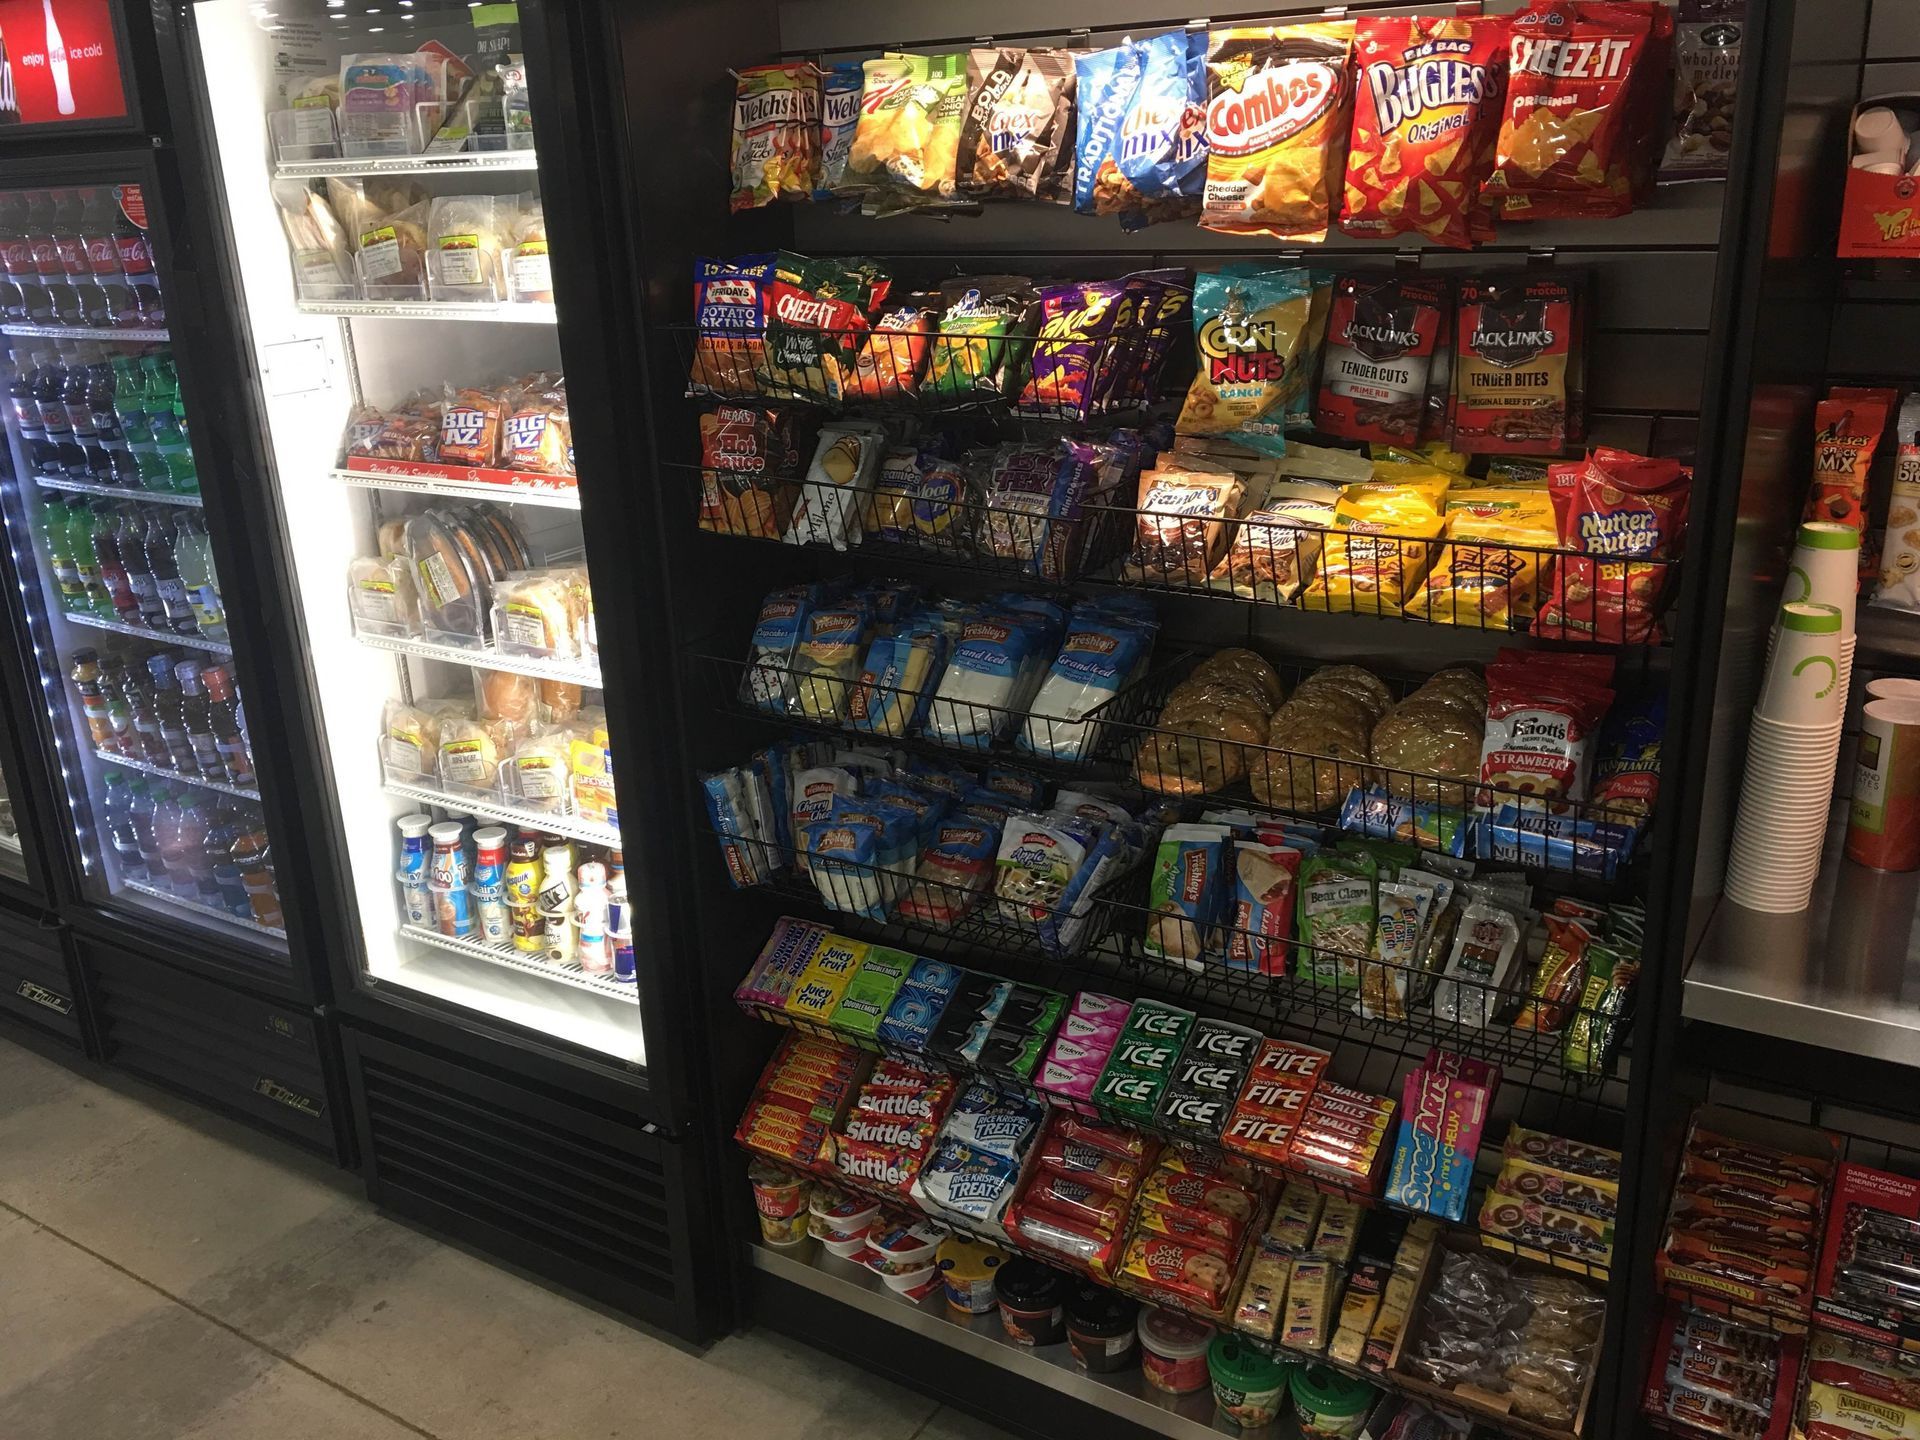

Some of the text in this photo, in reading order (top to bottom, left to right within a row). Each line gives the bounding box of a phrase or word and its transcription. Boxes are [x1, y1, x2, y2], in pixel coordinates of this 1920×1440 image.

[22, 43, 103, 66] enjoy ice cold
[1436, 41, 1472, 54] BAG
[971, 70, 1010, 121] BOLD
[1208, 70, 1322, 138] Combos
[1368, 60, 1485, 137] BUGLES
[739, 94, 789, 123] Welch's
[1207, 184, 1248, 194] Cheddar
[1208, 192, 1246, 202] Cheese
[1400, 290, 1439, 303] Protein
[1461, 287, 1477, 299] 70
[1525, 286, 1568, 297] Protein
[703, 308, 757, 321] POTATO
[776, 293, 837, 329] CHEEZ-IT
[1199, 318, 1276, 358] CORN
[1341, 320, 1420, 348] JACK LINK'S
[1470, 330, 1553, 349] JACK LINK'S
[1210, 354, 1285, 386] NUTS
[1340, 360, 1409, 385] TENDER CUTS
[1470, 371, 1549, 389] TENDER BITES
[1219, 386, 1263, 399] RANCH
[1349, 385, 1390, 399] PRIME RIB
[1469, 397, 1503, 407] ORIGINAL
[1504, 397, 1521, 406] BEEF
[442, 410, 485, 431] BIG
[504, 414, 547, 432] BIG
[445, 429, 480, 446] AZ
[508, 431, 541, 449] AZ
[719, 433, 757, 456] Hot
[711, 450, 765, 472] Sauce
[1822, 445, 1857, 458] SNACK
[1002, 492, 1046, 505] Cinnamon
[1060, 462, 1084, 517] Mini Donuts
[806, 492, 835, 540] Milano
[1582, 512, 1653, 536] Nutter
[1586, 530, 1659, 554] Butter
[1600, 562, 1654, 581] Bites
[762, 601, 796, 617] Freshley's
[756, 627, 789, 638] Cupcakes
[962, 626, 1008, 640] Freshley's
[984, 653, 1009, 666] Iced
[1057, 654, 1117, 679] Grand Iced
[1511, 718, 1566, 741] Knott's
[1494, 753, 1569, 771] STRAWBERRY
[797, 800, 829, 813] Cherry
[1358, 798, 1401, 816] NUTRI
[1353, 809, 1399, 827] GRAIN
[1513, 817, 1562, 831] NUTRI
[1011, 846, 1046, 862] Apple
[1493, 845, 1541, 864] NUTRI
[1166, 865, 1182, 897] Apple
[1311, 886, 1369, 905] Bear Claw
[1255, 906, 1273, 951] Cherry
[1380, 914, 1397, 951] Crunch
[769, 926, 797, 965] mentos
[776, 926, 806, 972] mentos
[788, 931, 819, 977] mentos
[821, 945, 854, 964] Juicy
[818, 956, 848, 974] Fruit
[864, 961, 901, 977] DOUBLEMINT
[799, 981, 834, 1002] Juicy
[904, 976, 950, 997] Winterfresh
[796, 994, 827, 1011] Fruit
[842, 999, 880, 1016] DOUBLEMINT
[1080, 997, 1109, 1013] Trident
[1137, 1005, 1168, 1016] Dentyne
[883, 1014, 929, 1036] Winterfresh
[1067, 1019, 1097, 1036] Trident
[1133, 1011, 1186, 1037] ICE
[1199, 1024, 1230, 1036] Dentyne
[1054, 1042, 1086, 1058] Trident
[1123, 1037, 1153, 1048] Dentyne
[1195, 1031, 1251, 1057] ICE
[792, 1053, 832, 1074] Starburst
[796, 1043, 838, 1065] Starburst
[1118, 1044, 1173, 1069] ICE
[1259, 1050, 1322, 1077] FIRE
[779, 1066, 820, 1086] Starburst
[1046, 1065, 1075, 1082] Trident
[1106, 1069, 1138, 1080] Dentyne
[1180, 1064, 1236, 1090] ICE
[772, 1079, 813, 1100] Starburst
[1102, 1076, 1158, 1102] ICE
[1244, 1083, 1307, 1111] FIRE
[1330, 1083, 1374, 1103] HALLS
[760, 1104, 801, 1126] Starburst
[857, 1095, 931, 1118] Skittles
[1323, 1099, 1366, 1119] HALLS
[974, 1121, 1027, 1139] TREATS
[977, 1114, 1031, 1127] RICE KRISPIES
[1319, 1116, 1361, 1136] HALLS
[846, 1120, 923, 1150] Skittles
[1228, 1117, 1294, 1146] FIRE
[1443, 1110, 1461, 1158] CHEWY
[987, 1140, 1010, 1150] Original
[837, 1150, 910, 1185] Skittles
[1549, 1154, 1619, 1176] Caramel Crea
[1742, 1151, 1773, 1165] Almond
[951, 1173, 1006, 1188] RICE KRISPIES
[1177, 1177, 1204, 1190] Soft
[1845, 1175, 1913, 1198] CHERRY CASHEW
[1846, 1168, 1918, 1191] DARK CHOCOLATE
[950, 1180, 1002, 1200] TREATS
[1053, 1185, 1091, 1197] Butter
[1167, 1185, 1205, 1200] Batch
[1543, 1194, 1588, 1212] Caramel
[1730, 1219, 1760, 1233] Almond
[1522, 1225, 1609, 1253] Caramel Creams
[1147, 1254, 1184, 1270] Batch
[1157, 1244, 1184, 1262] Soft
[1667, 1267, 1754, 1299] NATURE VALLEY
[1840, 1395, 1903, 1422] NATURE VALLEY
